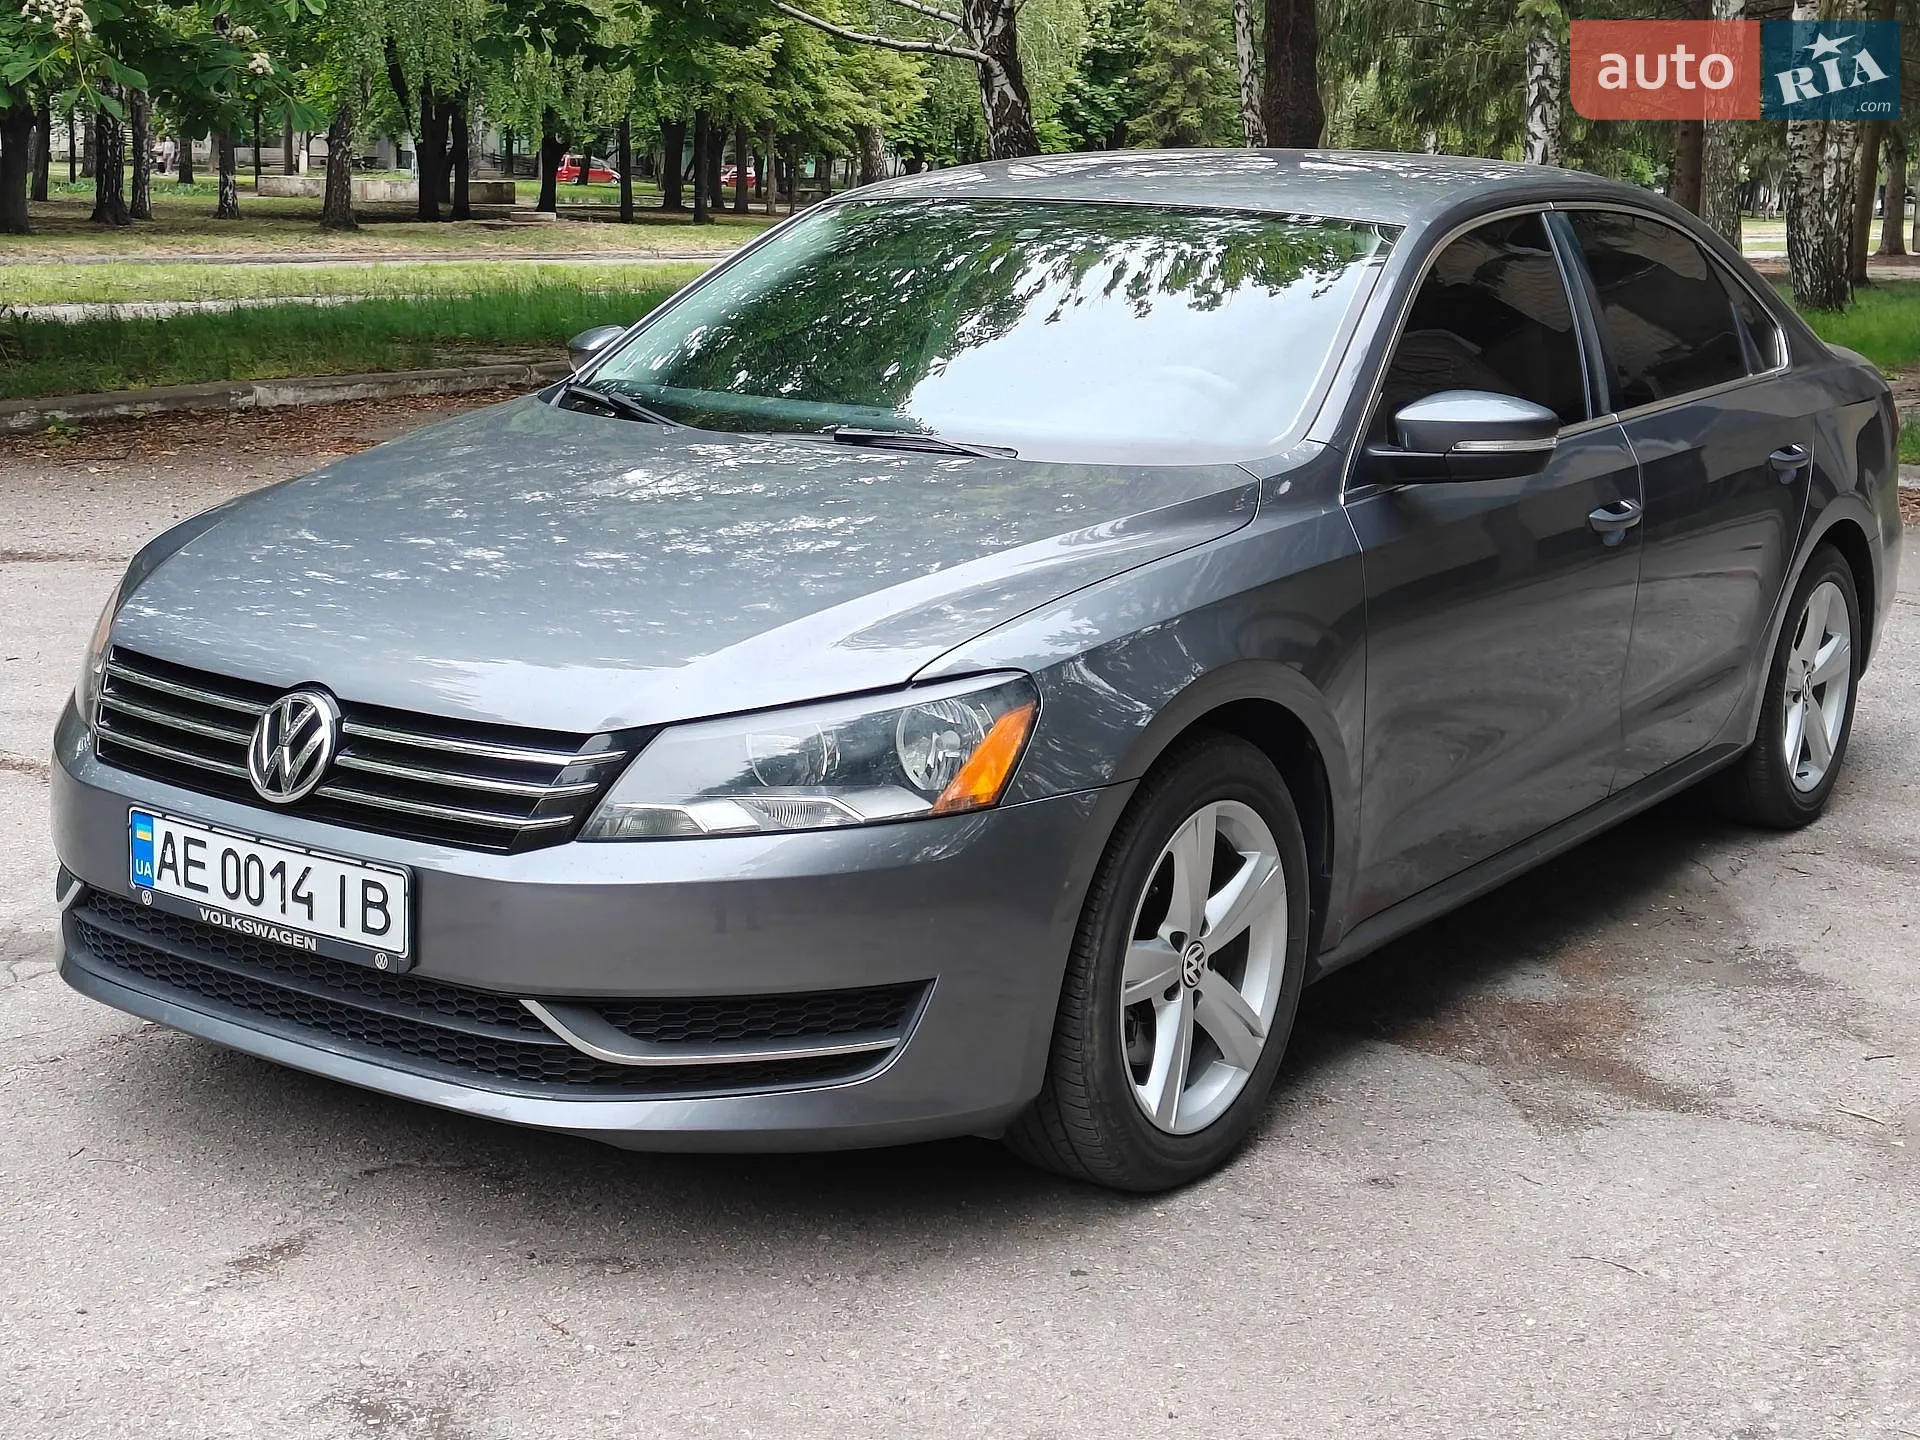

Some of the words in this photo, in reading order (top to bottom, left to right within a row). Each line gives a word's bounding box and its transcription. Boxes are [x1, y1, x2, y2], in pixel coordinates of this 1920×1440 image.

[248, 692, 332, 803] VW
[135, 858, 153, 878] UA
[157, 830, 209, 893] AE
[220, 847, 314, 921] 0014
[339, 873, 392, 936] IB
[199, 907, 317, 952] VOLKSWAGEN
